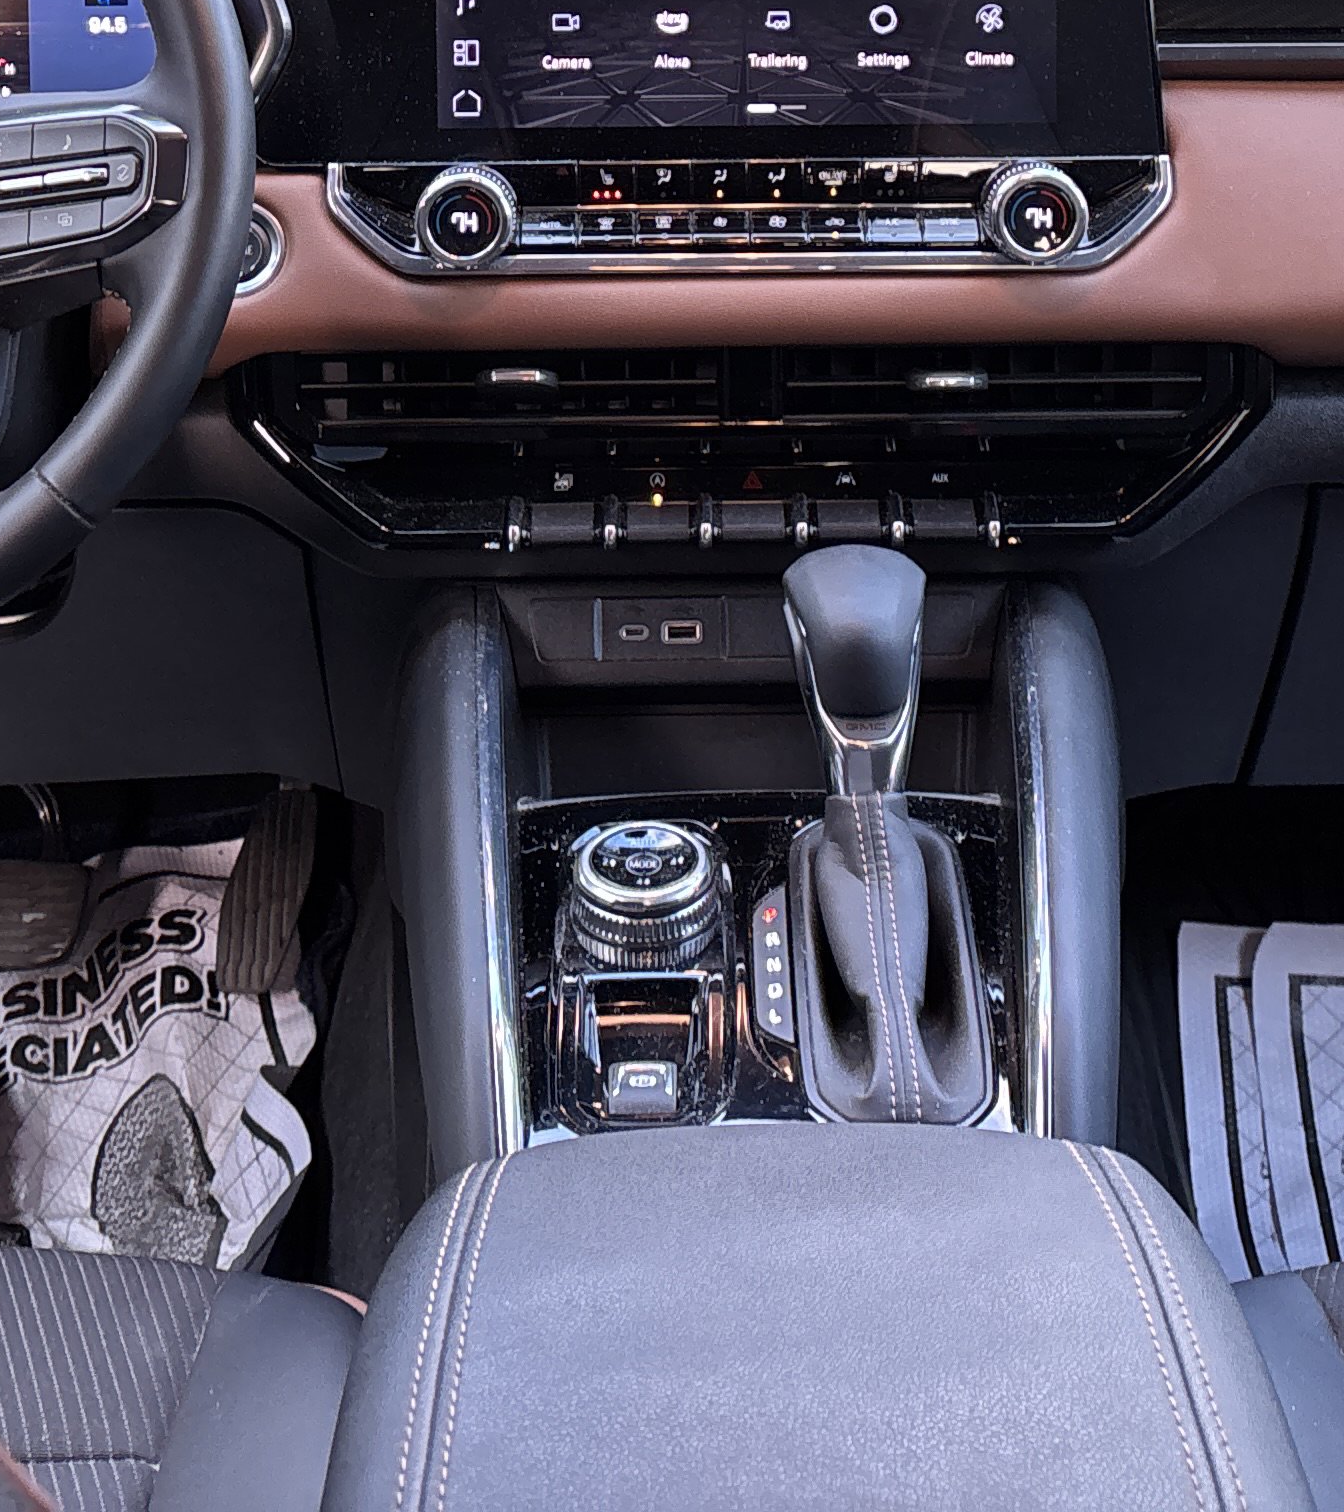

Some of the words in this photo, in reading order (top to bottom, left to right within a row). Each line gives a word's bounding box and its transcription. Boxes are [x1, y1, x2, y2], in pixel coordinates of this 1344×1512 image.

[541, 54, 592, 70] Camera
[654, 54, 691, 70] Alexa
[748, 52, 808, 71] Trailering
[857, 51, 910, 70] Settings
[965, 51, 1014, 66] Climate
[450, 211, 479, 233] 74
[1025, 206, 1054, 229] 74
[766, 956, 782, 973] N
[767, 982, 784, 1000] D
[768, 1008, 782, 1025] L
